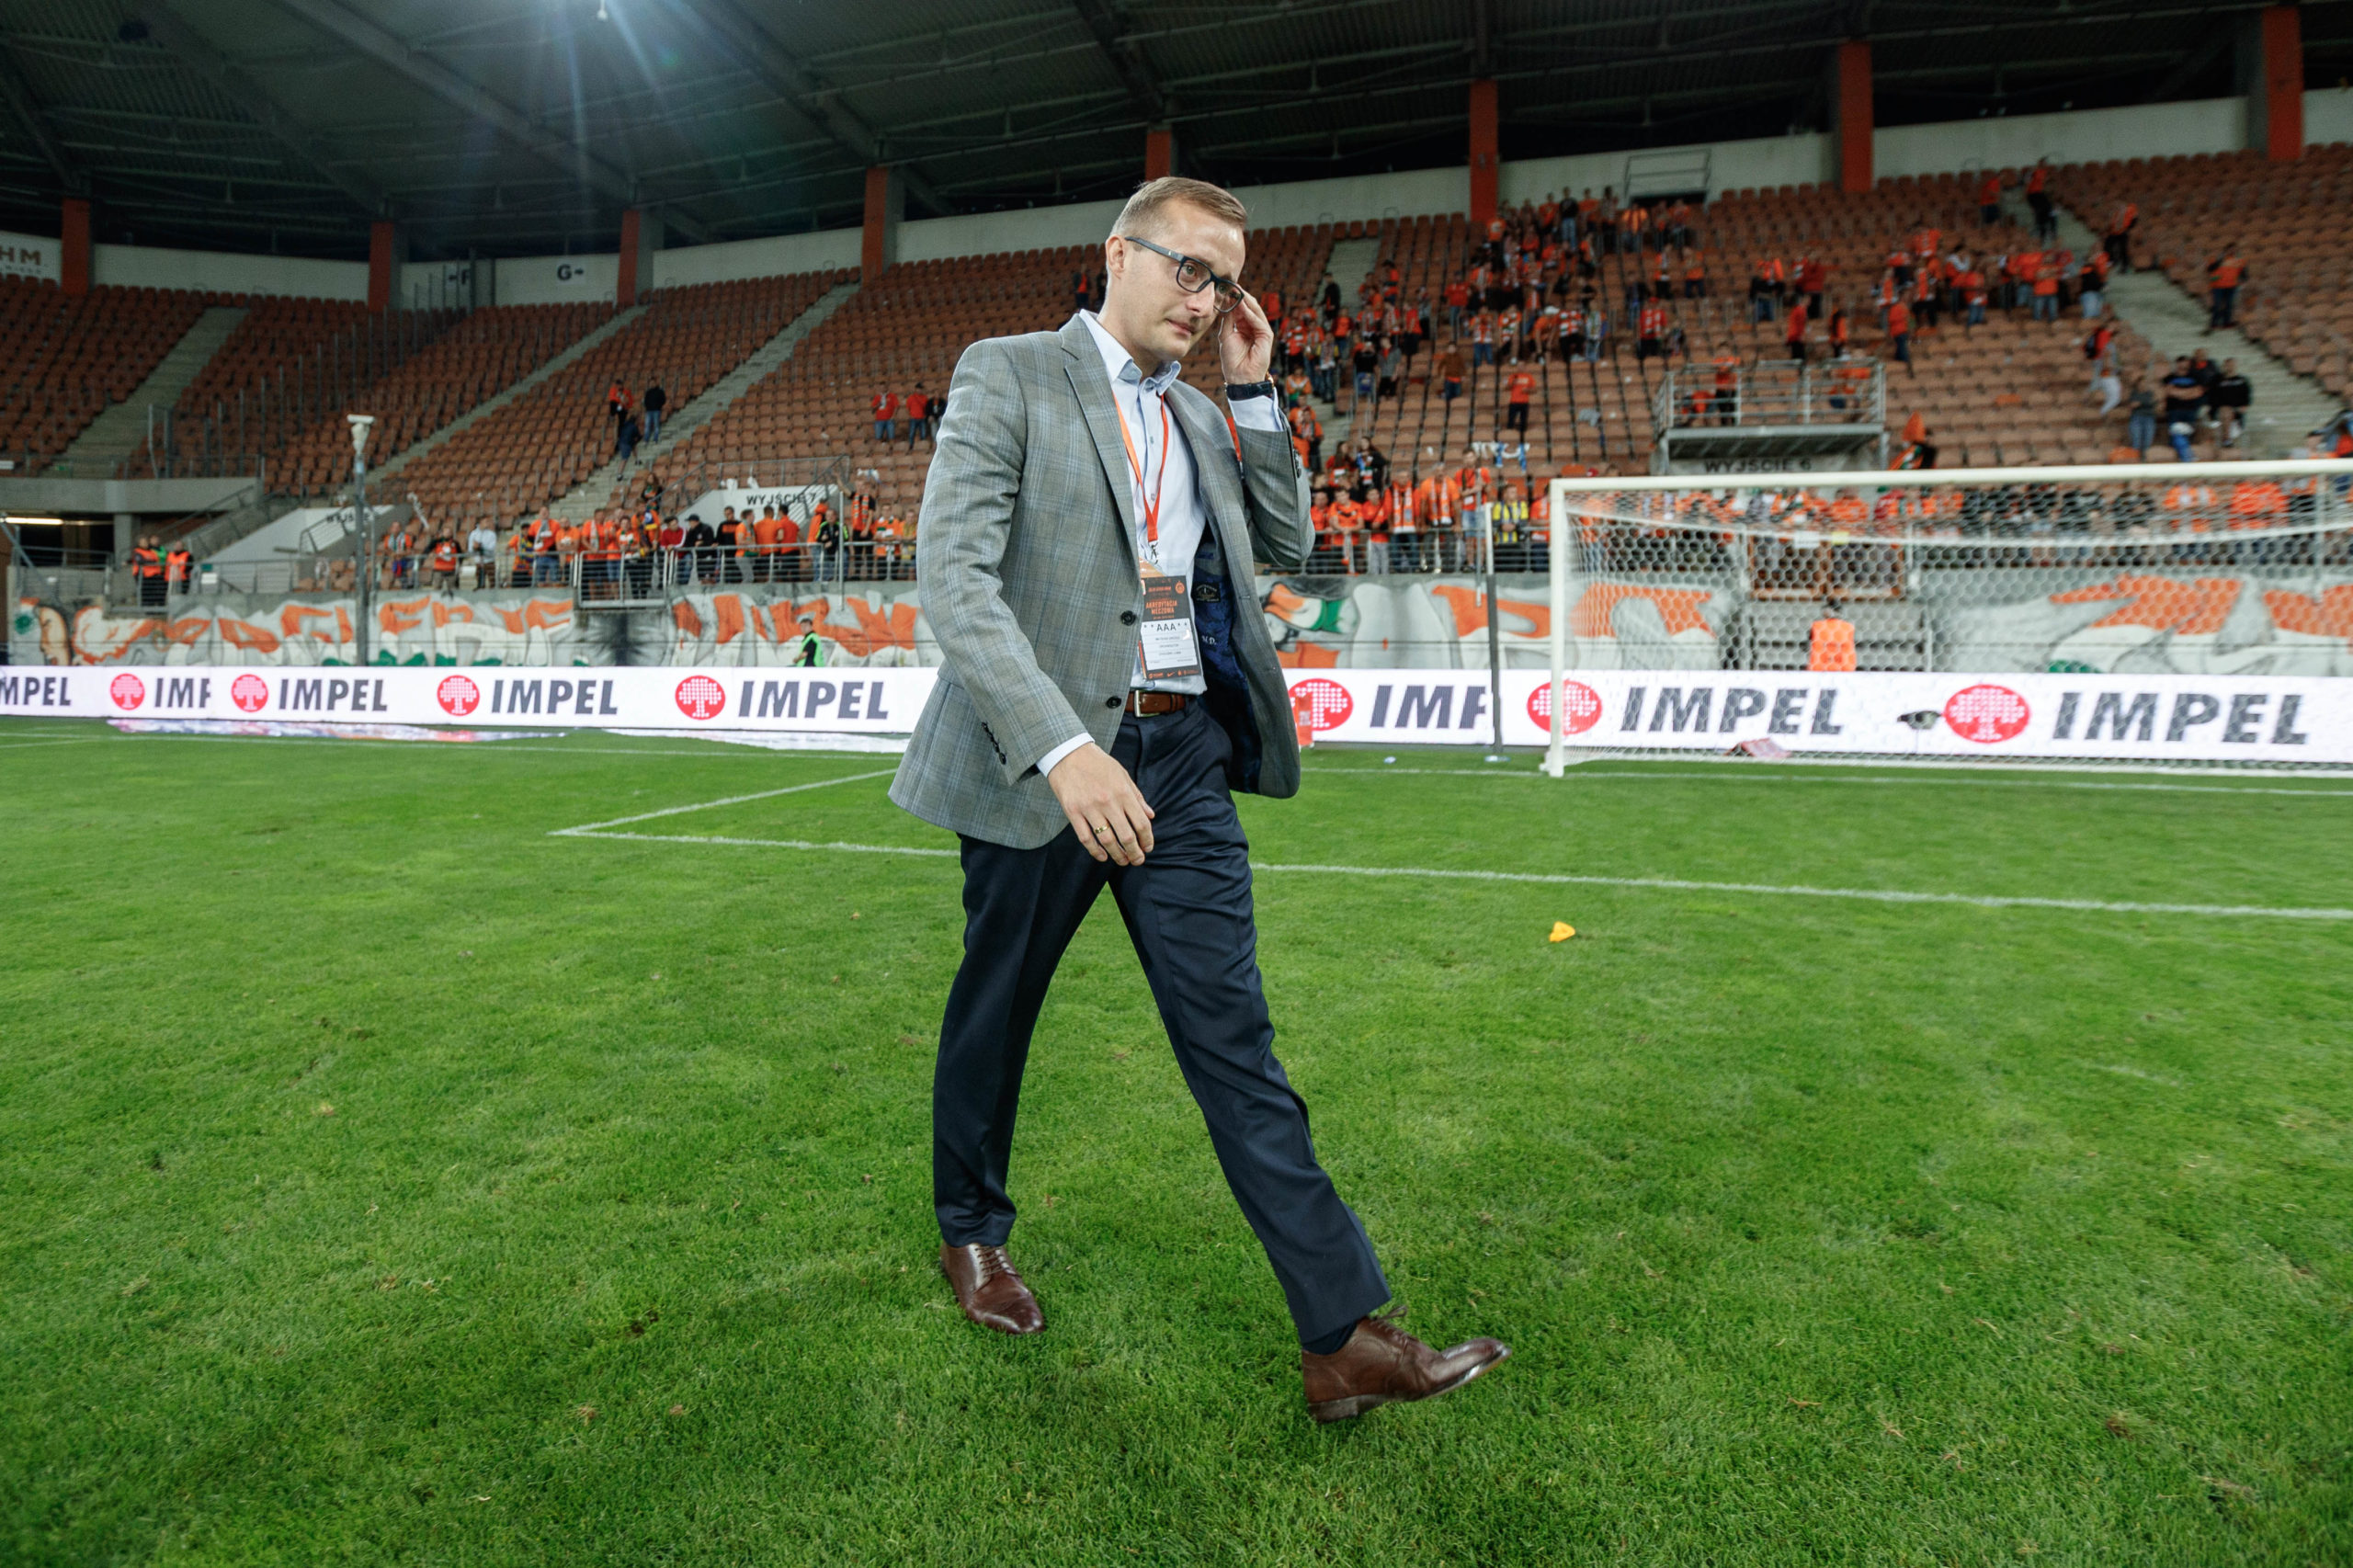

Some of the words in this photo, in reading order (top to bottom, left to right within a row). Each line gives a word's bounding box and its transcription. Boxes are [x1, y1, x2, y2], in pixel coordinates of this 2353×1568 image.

[556, 264, 573, 281] G
[278, 678, 387, 711] IMPEL
[492, 680, 617, 715] IMPEL
[738, 681, 888, 720] IMPEL
[1620, 687, 1844, 734] IMPEL
[2052, 692, 2308, 744] IMPEL
